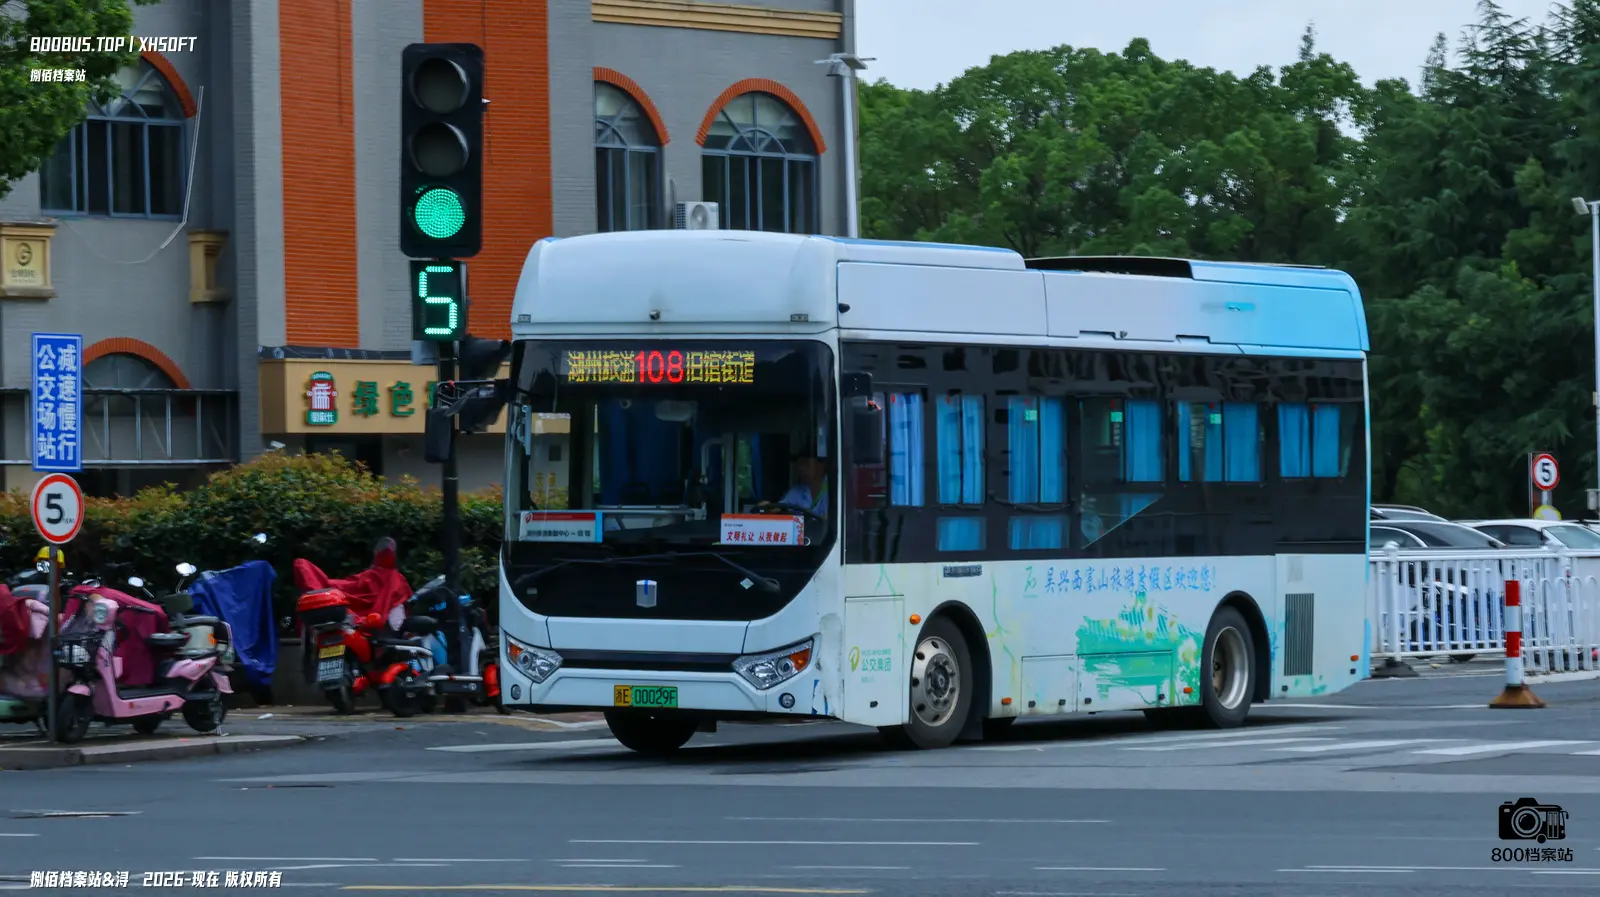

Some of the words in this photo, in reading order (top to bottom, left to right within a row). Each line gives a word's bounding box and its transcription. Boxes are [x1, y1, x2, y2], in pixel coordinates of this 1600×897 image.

[419, 266, 457, 334] 5
[634, 350, 684, 383] 108
[36, 344, 56, 461] 公交场站
[57, 344, 77, 461] 减速慢行
[352, 380, 438, 418] 绿色
[1542, 463, 1552, 482] 5
[46, 493, 65, 525] 5
[726, 531, 755, 542] 文明礼让
[758, 532, 788, 542] 从我做起
[861, 657, 892, 672] 公交集团
[634, 689, 676, 705] 00029F
